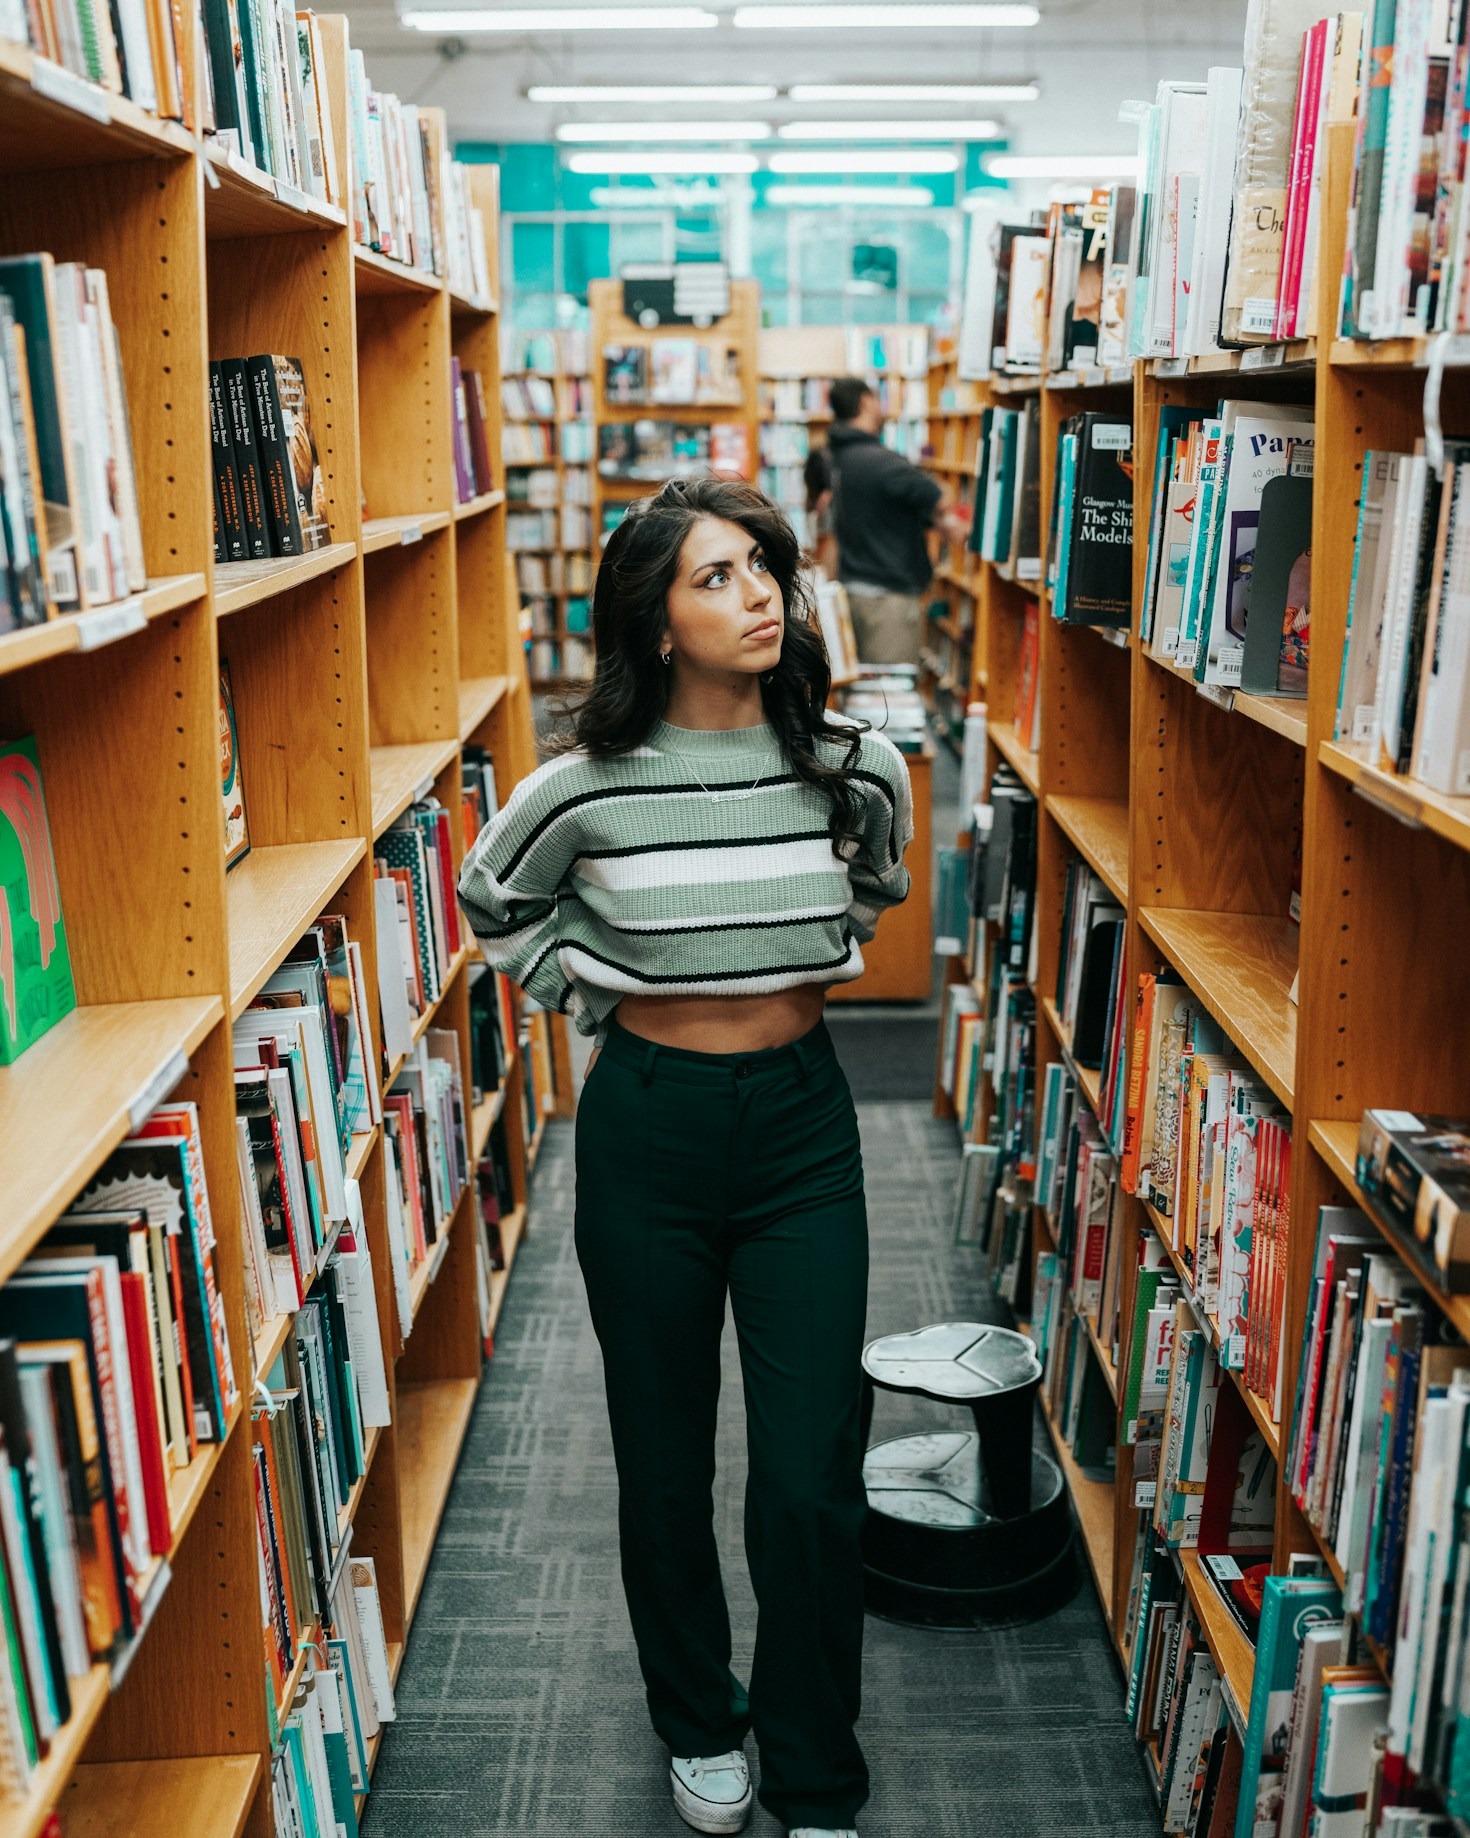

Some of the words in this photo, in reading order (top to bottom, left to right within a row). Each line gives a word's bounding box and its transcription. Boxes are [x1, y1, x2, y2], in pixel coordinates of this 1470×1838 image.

[240, 404, 248, 428] Artisan
[269, 424, 277, 442] Bread
[243, 428, 251, 446] Bread
[1205, 470, 1215, 479] PA
[1252, 469, 1263, 479] 40
[1265, 466, 1286, 478] dyna
[1082, 496, 1115, 509] Glasgow
[1117, 499, 1133, 509] Mus
[1253, 486, 1263, 494] fo
[1082, 508, 1108, 525] The
[1111, 511, 1133, 527] Shi
[1080, 526, 1133, 545] Models
[1111, 599, 1132, 607] Comple
[1131, 1027, 1146, 1069] SANDRA
[1128, 1068, 1142, 1110] BETZINA
[1123, 1115, 1136, 1146] Betzina
[244, 1129, 257, 1183] BREAD
[1123, 1145, 1131, 1155] &
[1229, 1145, 1239, 1183] Sew
[1226, 1186, 1237, 1231] Retro
[1251, 1186, 1260, 1255] SUNDRESSING
[1258, 1190, 1267, 1259] SUNDRESSING
[1265, 1194, 1274, 1264] SUNDRESSING
[1273, 1198, 1282, 1267] SUNDRESSING
[204, 1265, 221, 1323] FISH
[1178, 1340, 1189, 1377] SEW
[1165, 1380, 1184, 1483] SERENDIPITY
[1190, 1483, 1196, 1492] 2
[1261, 1599, 1273, 1668] KNITTING
[1199, 1660, 1216, 1675] NE
[1294, 1684, 1307, 1740] WEAVING
